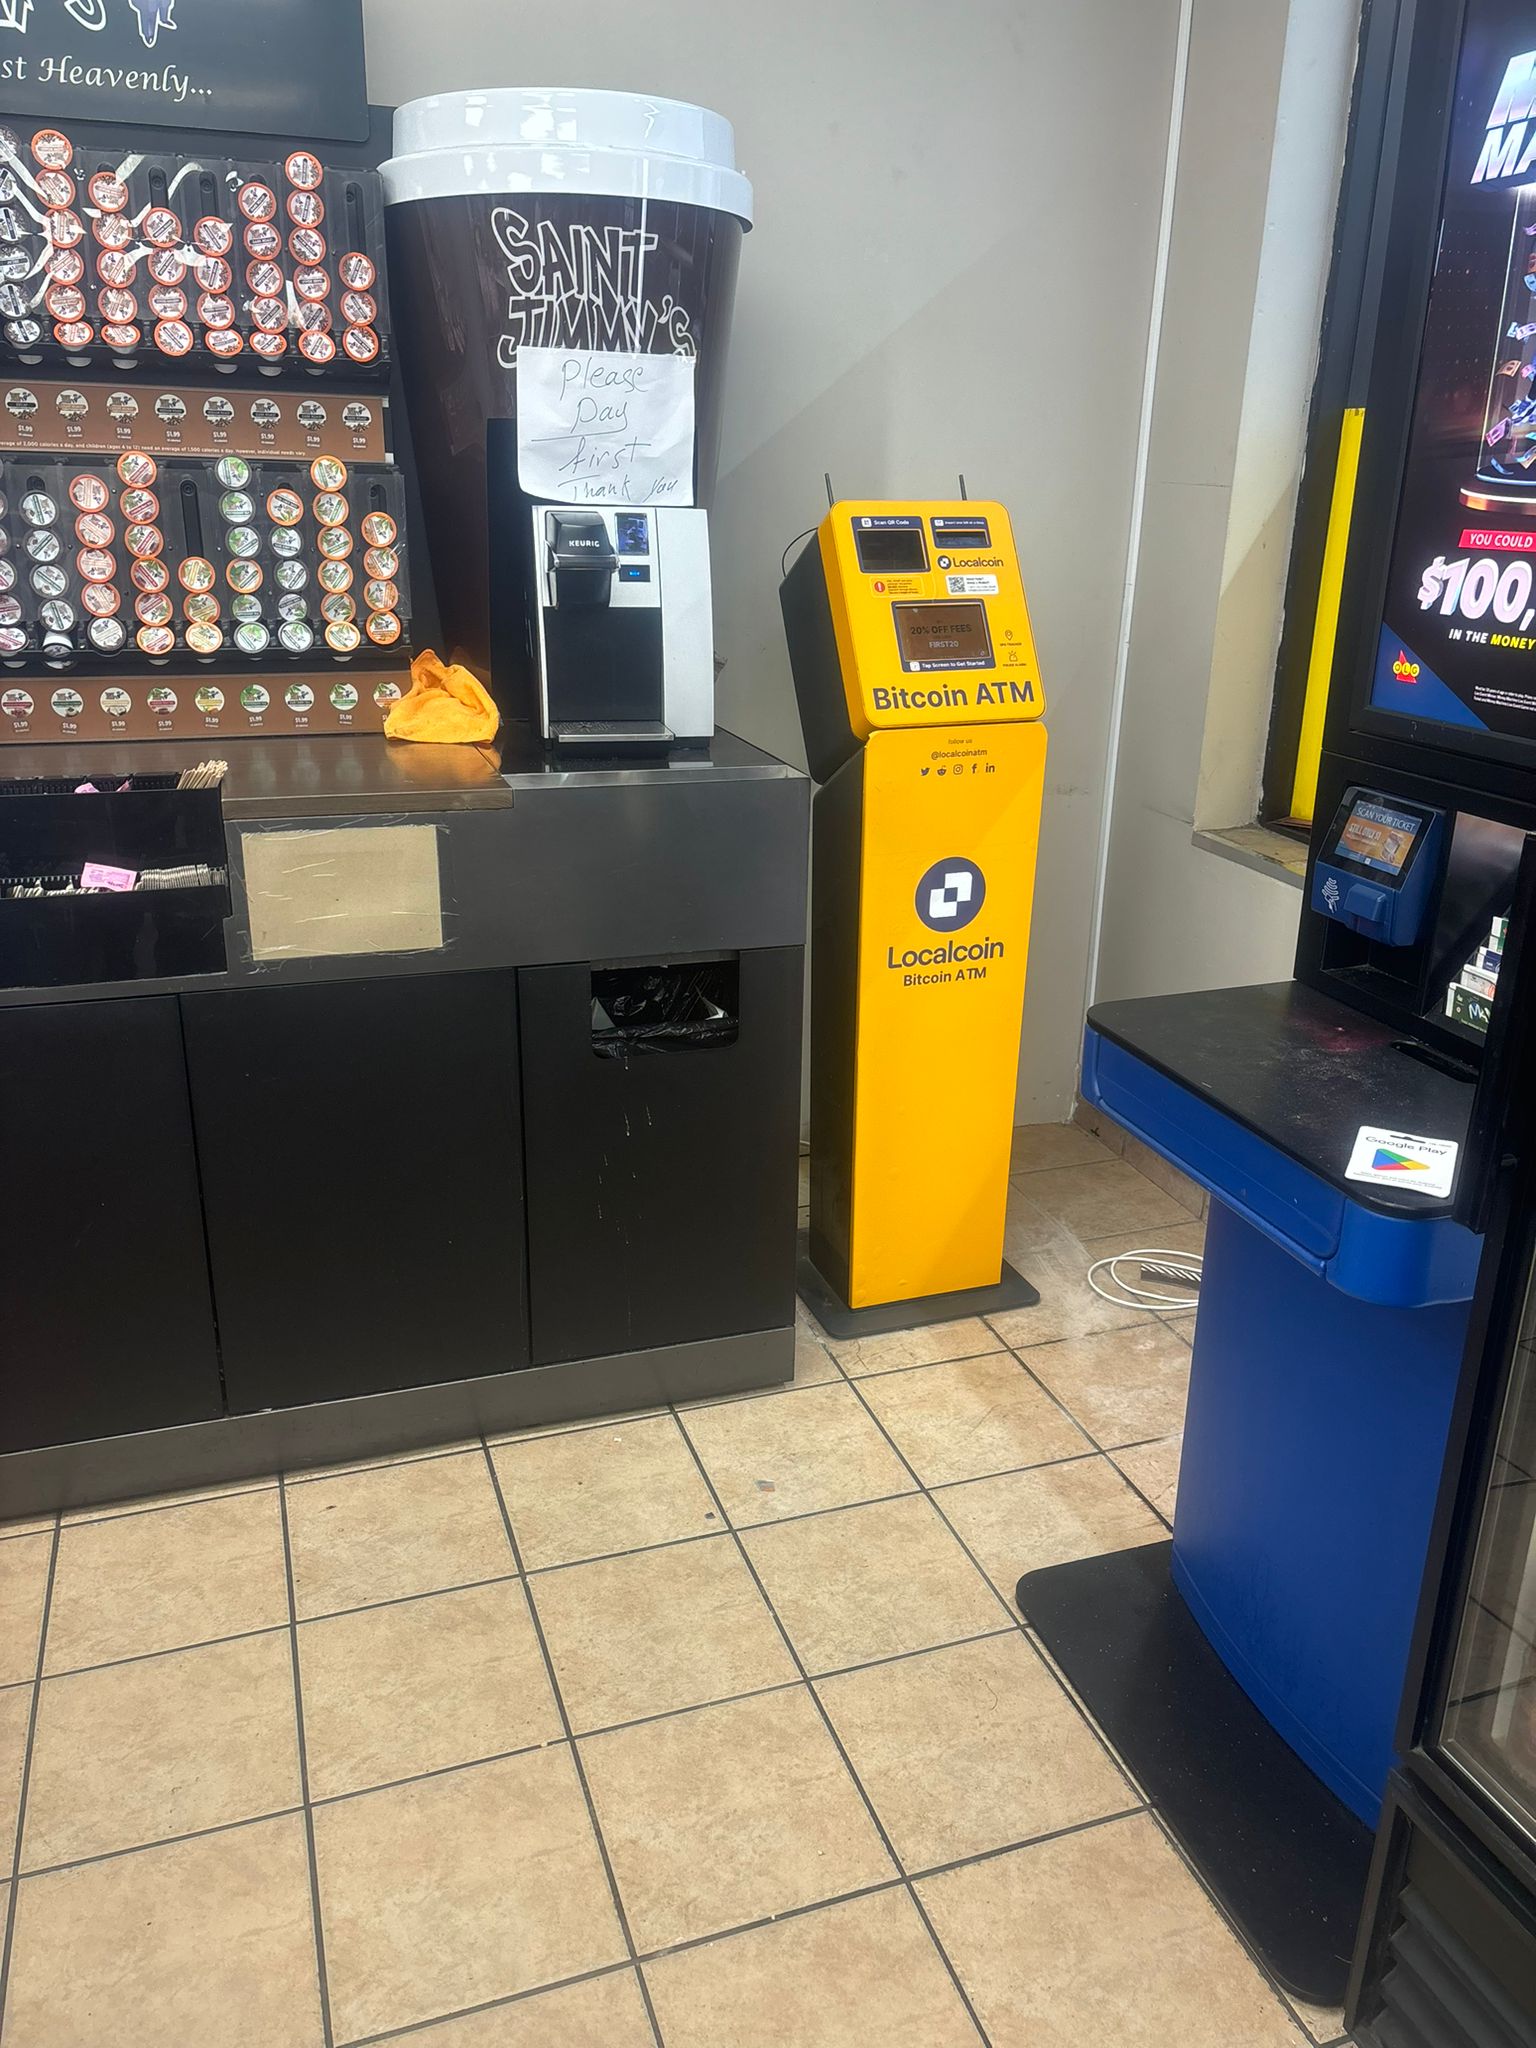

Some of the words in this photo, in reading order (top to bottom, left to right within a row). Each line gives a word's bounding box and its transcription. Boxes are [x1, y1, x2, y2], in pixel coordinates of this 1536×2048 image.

[38, 55, 212, 102] Heavenly...
[491, 207, 659, 303] SAINT
[497, 295, 697, 368] JIMMY'S
[560, 357, 648, 401] Please
[18, 424, 33, 433] $1.99
[307, 435, 320, 443] $1.99
[568, 540, 600, 548] KEURIG
[1469, 533, 1493, 546] YOU
[1494, 535, 1533, 548] COULD
[952, 556, 1004, 568] Localcoin
[910, 626, 929, 635] 20%
[931, 625, 949, 634] OFF
[950, 623, 972, 633] FEES
[928, 640, 959, 648] FIRST20
[1448, 628, 1463, 640] IN
[1465, 630, 1489, 644] THE
[1490, 633, 1536, 650] MONEY
[1392, 661, 1420, 678] OLG
[872, 684, 968, 710] Bitcoin
[976, 680, 1035, 705] ATM
[62, 722, 77, 730] $1.99
[205, 716, 219, 724] $1.99
[930, 748, 988, 761] @localcoinatm
[1356, 807, 1374, 820] SCAN
[1374, 812, 1393, 826] YOUR
[1392, 818, 1416, 832] TICKET
[887, 936, 1005, 969] Localcoin
[903, 970, 952, 987] Bitcoin
[955, 966, 987, 981] ATM
[1365, 1135, 1414, 1149] Google
[1419, 1145, 1448, 1156] Play
